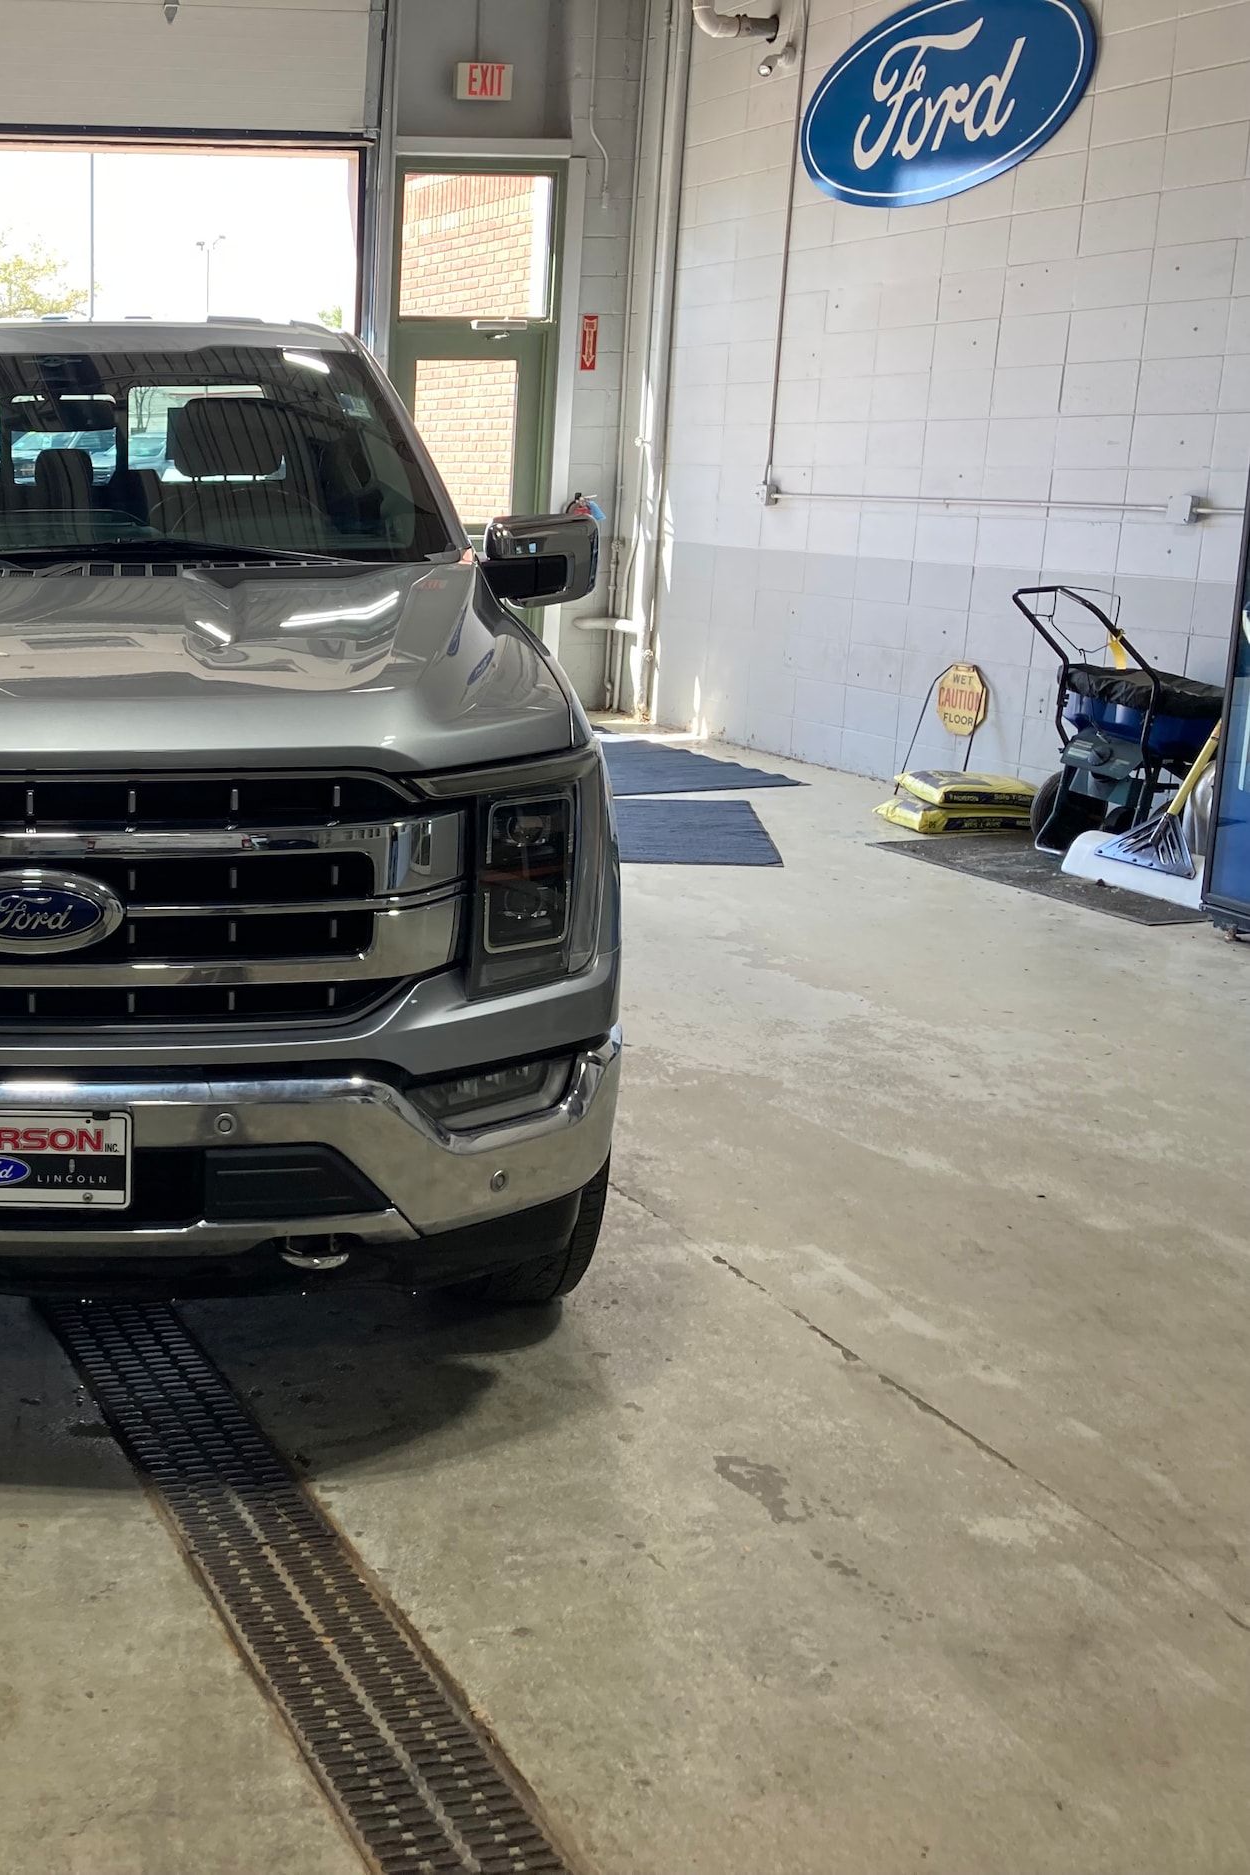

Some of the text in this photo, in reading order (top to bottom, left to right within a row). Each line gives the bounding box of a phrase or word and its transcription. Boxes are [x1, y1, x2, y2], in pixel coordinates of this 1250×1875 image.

[468, 64, 505, 96] EXIT
[853, 17, 1027, 170] Ford
[953, 674, 974, 685] WET
[938, 686, 981, 712] CAUTION
[943, 712, 974, 726] FLOOR
[104, 1143, 120, 1153] INC.
[37, 1174, 108, 1184] LINCOLN
